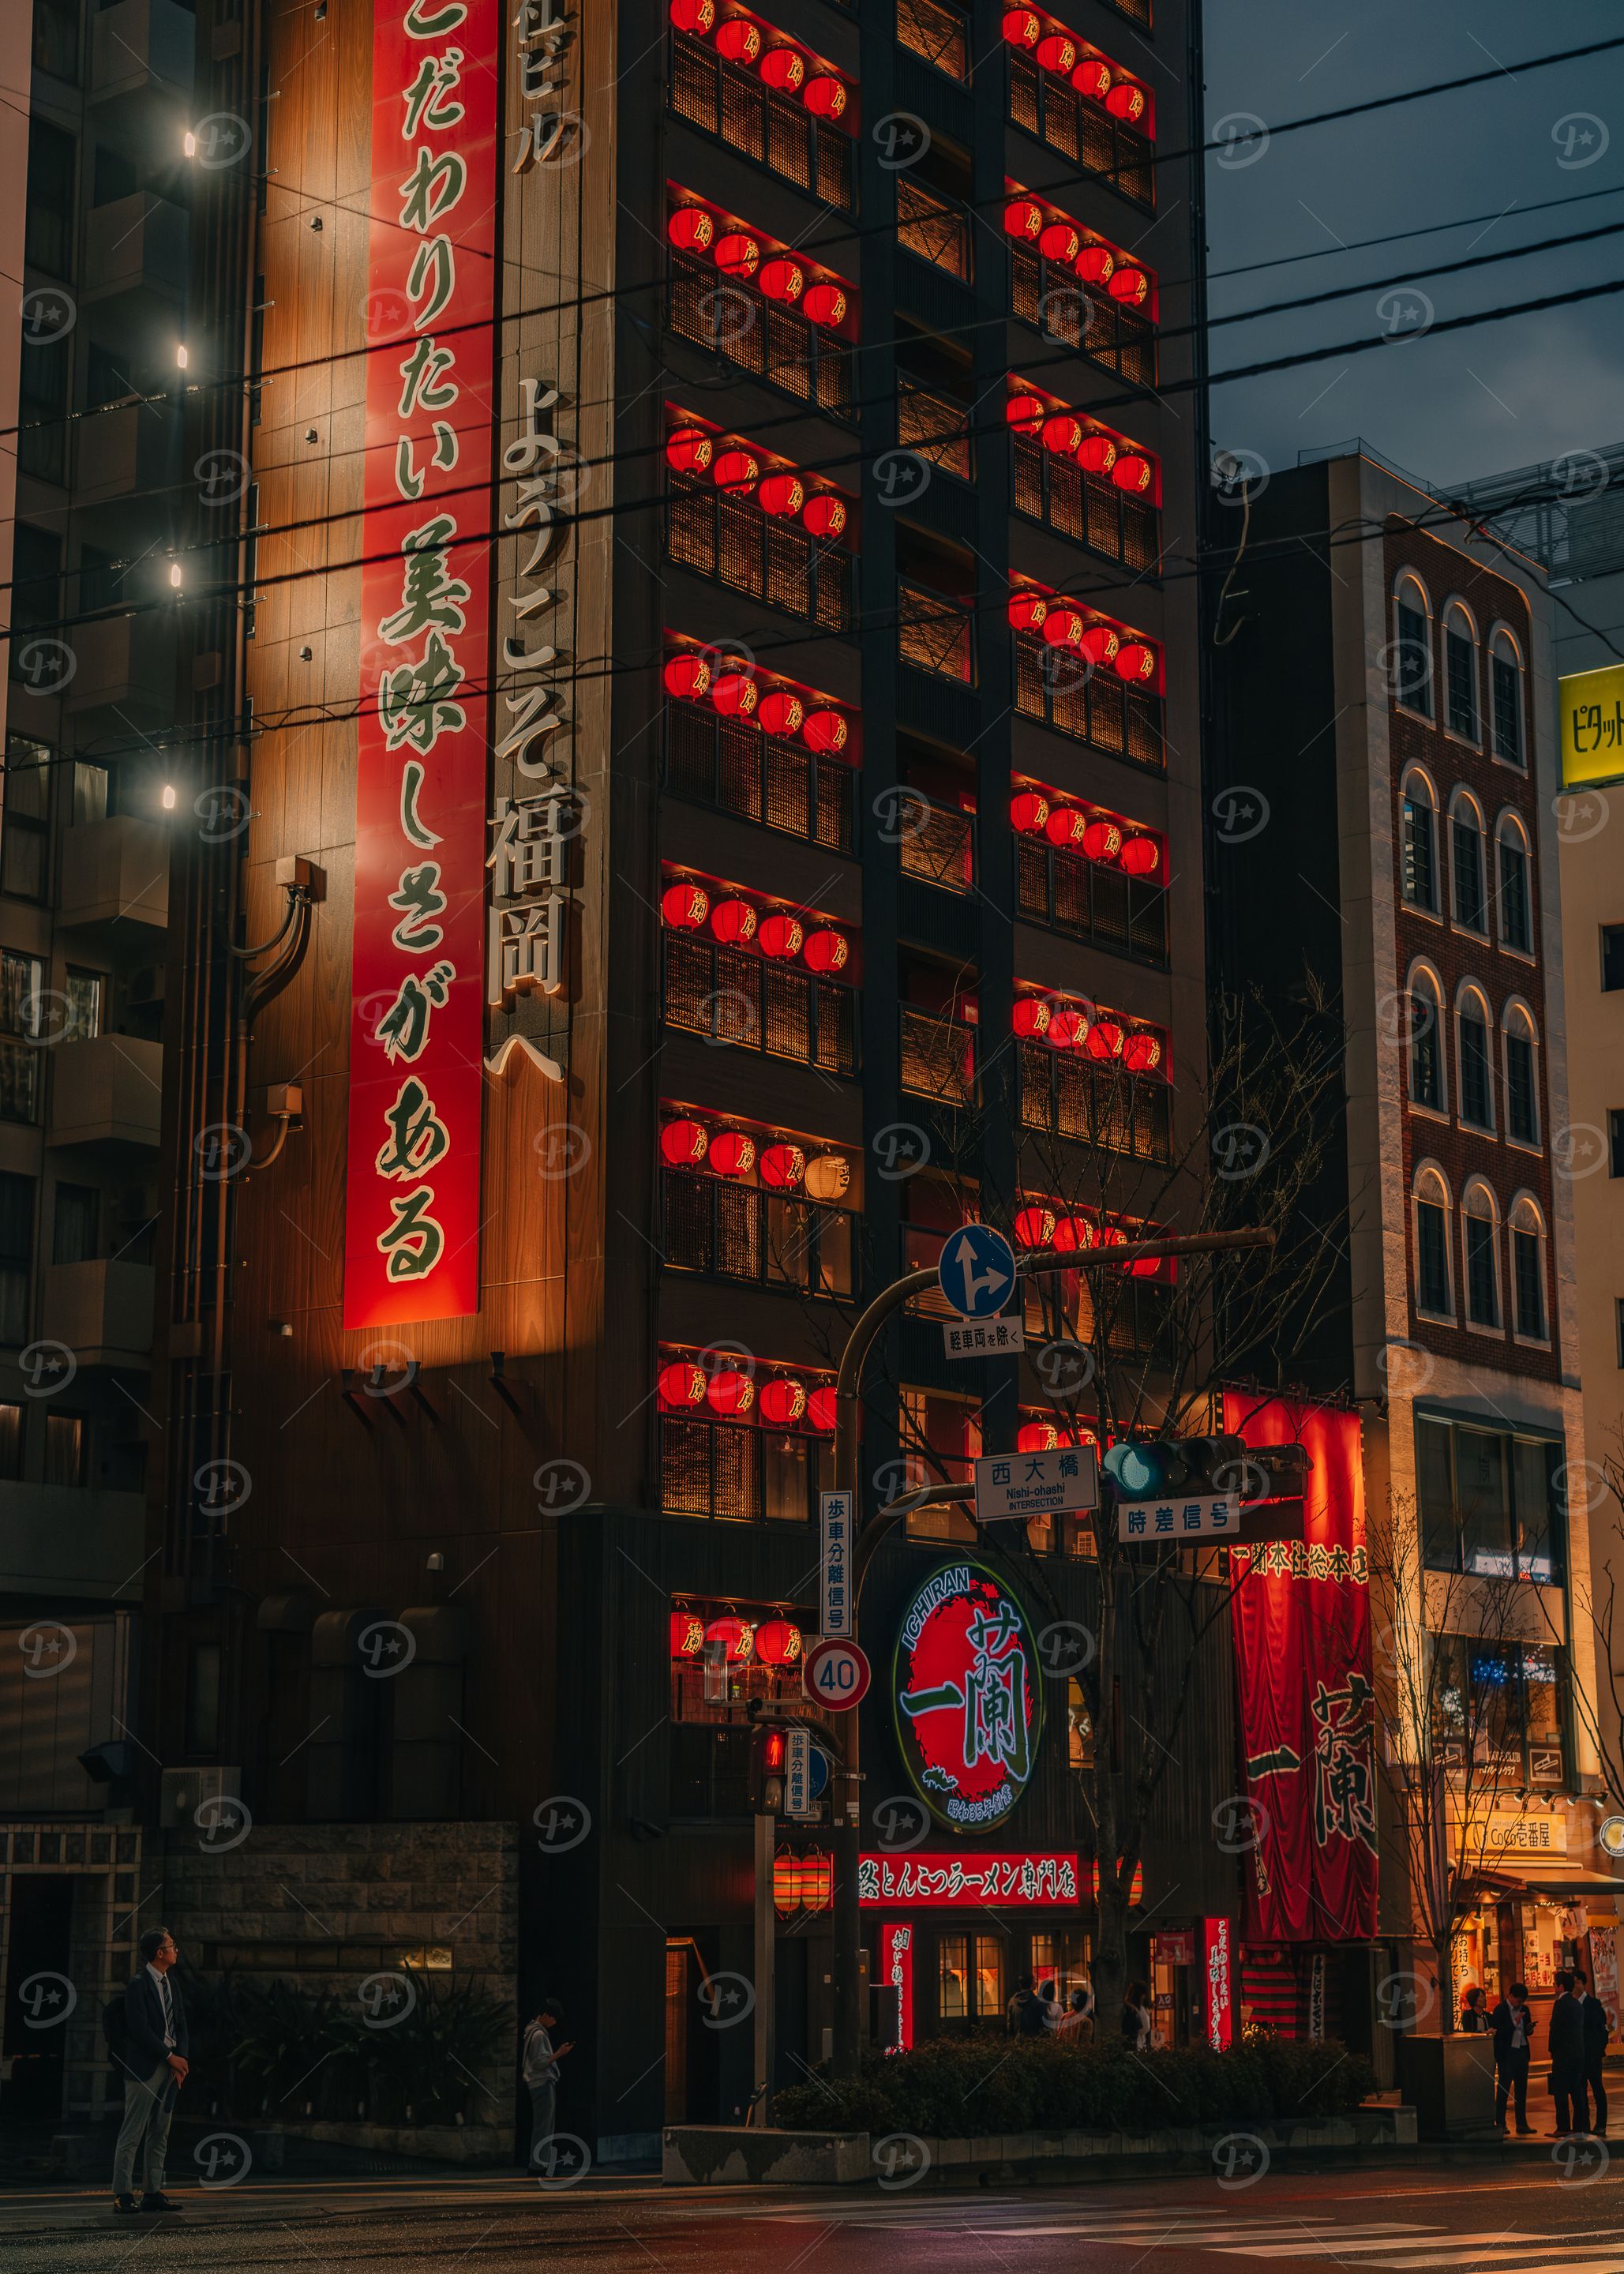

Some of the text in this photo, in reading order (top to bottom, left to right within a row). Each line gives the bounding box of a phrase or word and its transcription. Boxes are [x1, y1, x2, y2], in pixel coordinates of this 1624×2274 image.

[484, 377, 572, 1083] ようこそ福岡へ
[950, 1325, 1018, 1351] 軽車両を除く
[992, 1454, 1078, 1485] 西大橋
[1007, 1482, 1065, 1499] Nishi-ohashi
[1009, 1496, 1063, 1510] INTERSECTION
[1128, 1502, 1229, 1534] 時差信号
[827, 1499, 844, 1628] 歩車分離信号
[901, 1567, 970, 1651] ICHIRAN
[819, 1660, 854, 1690] 40
[900, 1600, 1030, 1782] 一蘭
[790, 1733, 804, 1811] 歩車分離信号
[1247, 1671, 1378, 1859] 一蘭
[947, 1784, 1013, 1822] 昭和35年創業
[1491, 1821, 1550, 1847] CoCo壱番屋
[1458, 1934, 1468, 1977] お持ち
